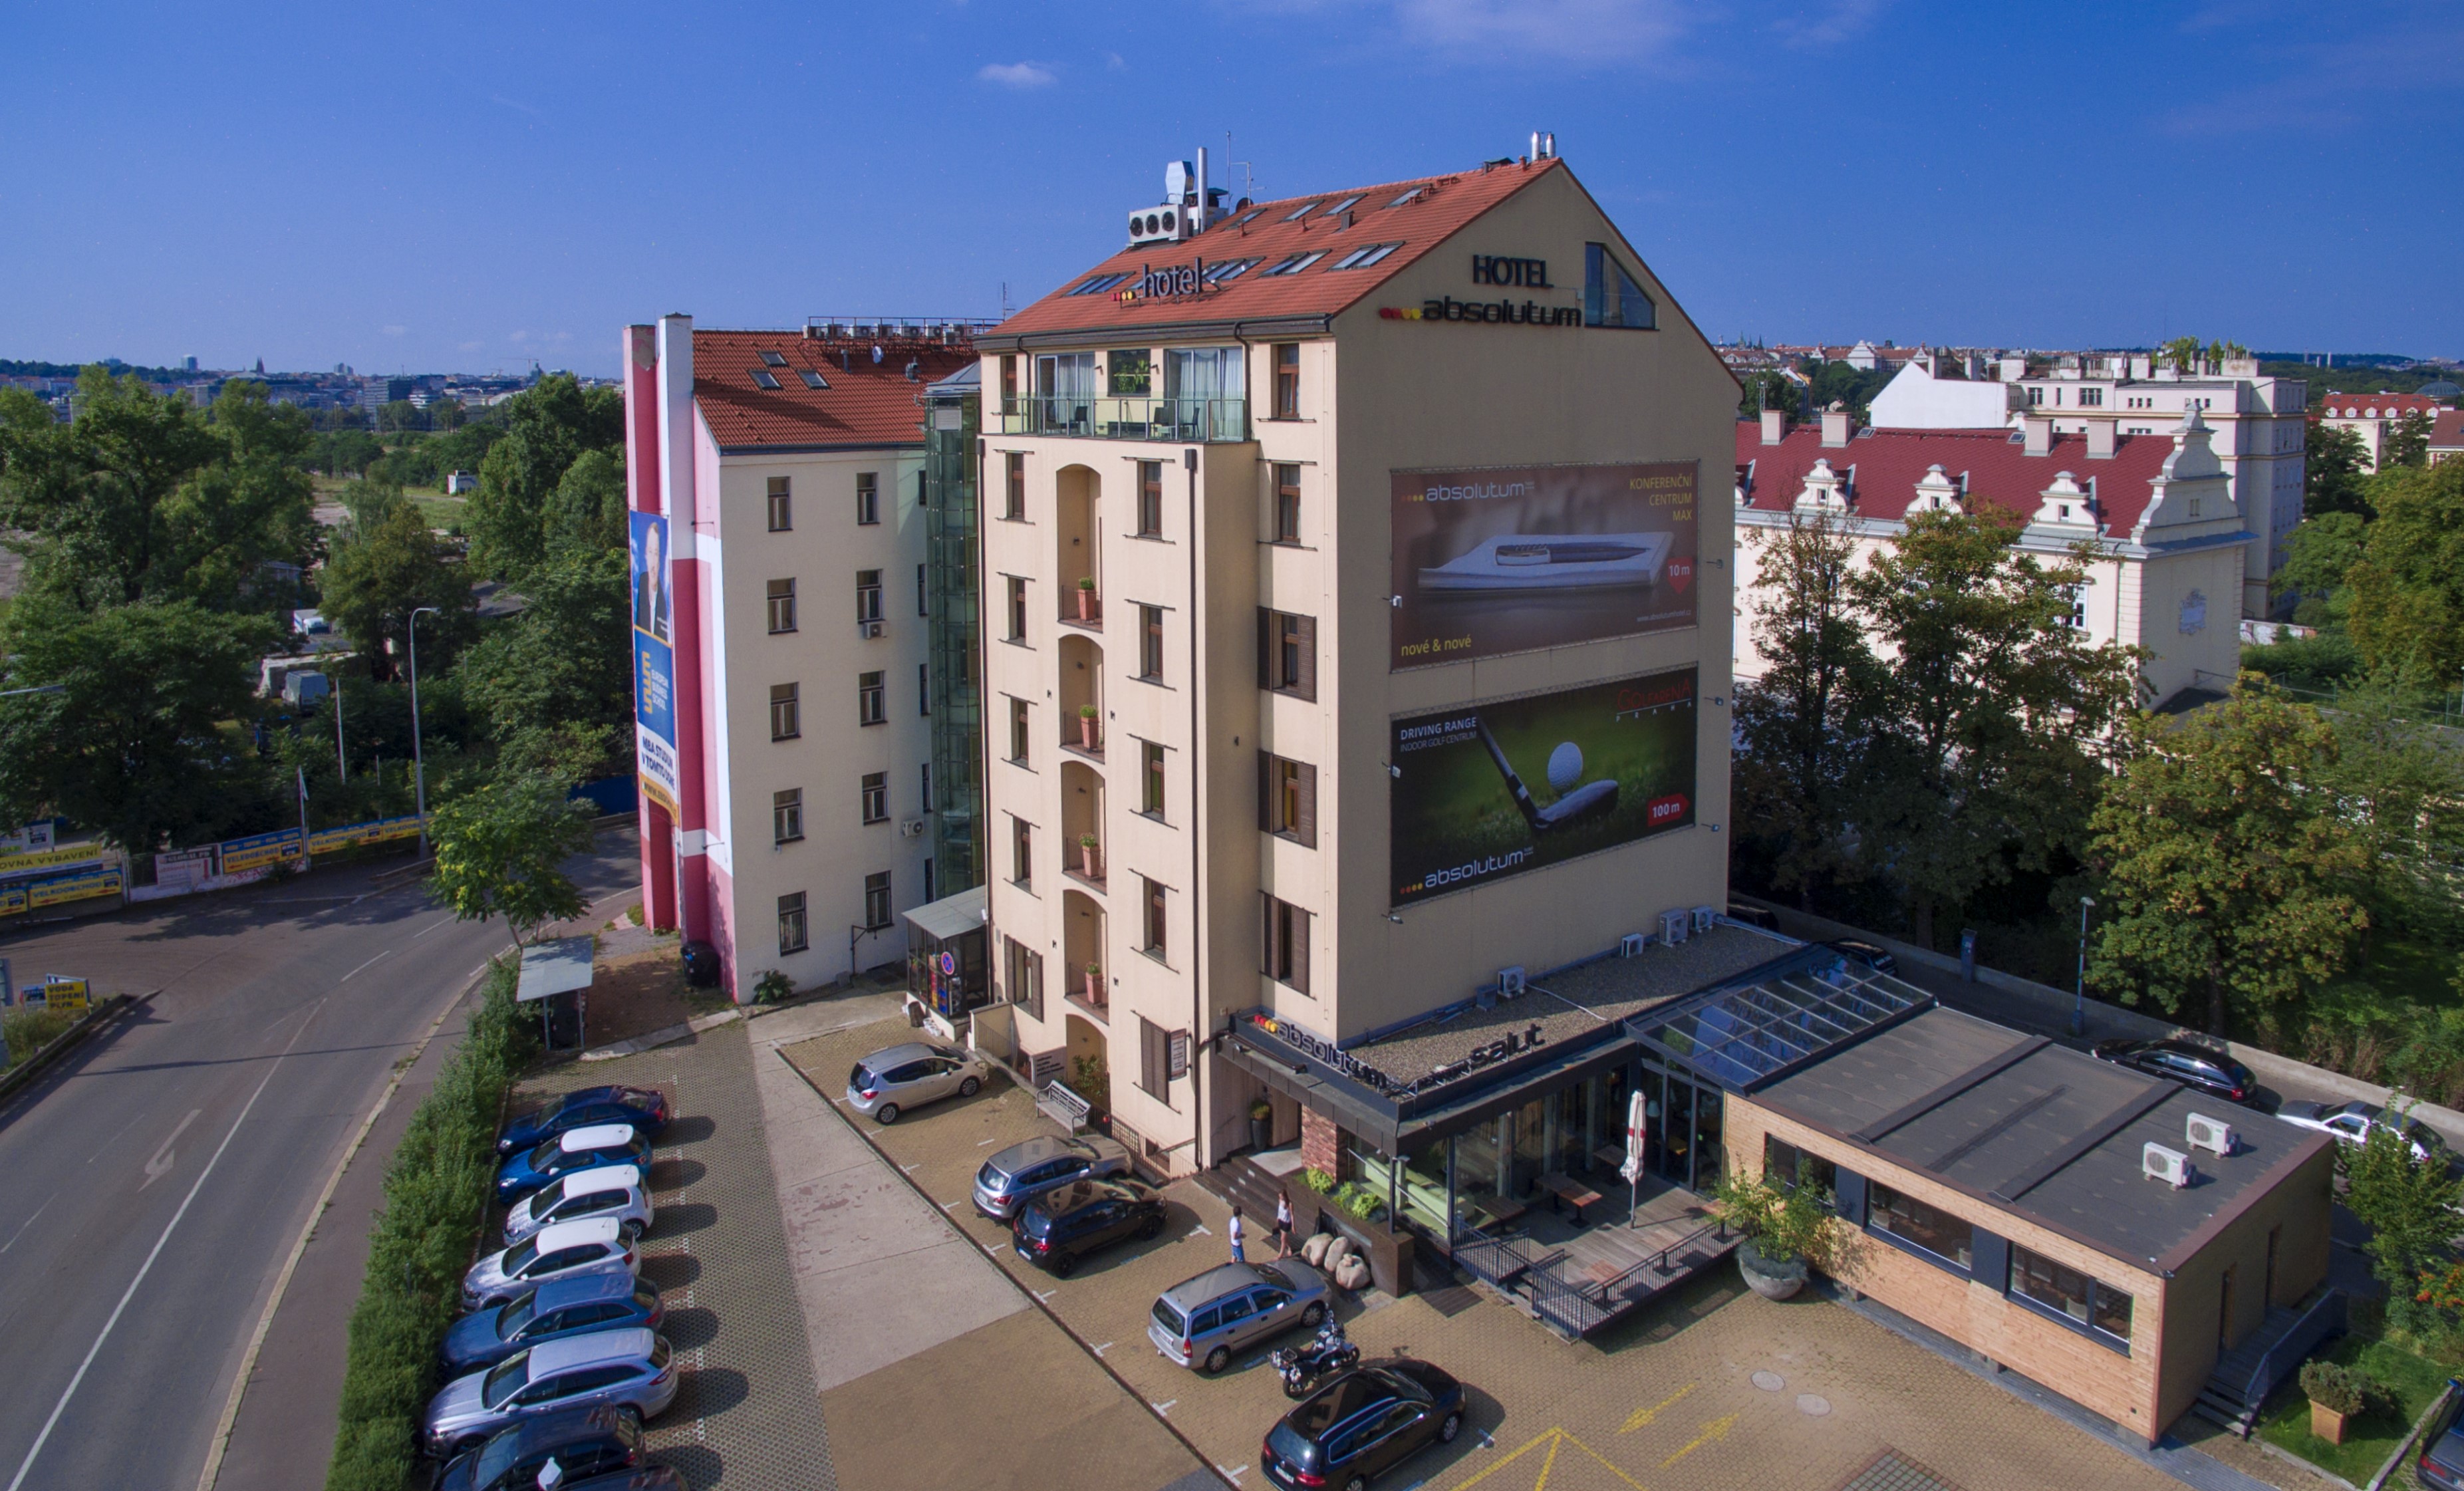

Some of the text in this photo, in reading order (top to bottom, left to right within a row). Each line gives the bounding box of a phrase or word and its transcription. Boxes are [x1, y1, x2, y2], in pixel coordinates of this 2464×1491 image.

[1143, 257, 1202, 298] hotel
[1472, 254, 1555, 289] HOTEL
[1423, 295, 1582, 327] absolutum
[1426, 481, 1524, 502] absolutum
[1629, 472, 1693, 489] KONFERENČNÍ
[1649, 492, 1692, 506] CENTRUM
[1673, 509, 1693, 521] MAX
[1669, 564, 1690, 577] 10 m
[1401, 634, 1472, 656] nové & nové
[1617, 678, 1693, 711] GOLFARENA
[1400, 717, 1477, 740] DRIVING RANGE
[1400, 730, 1477, 753] INDOOR GOLF CENTRUM
[1653, 803, 1680, 818] 100 m
[38, 847, 98, 865] VYBAVENÍ
[1425, 850, 1523, 888] absolutum
[33, 881, 102, 898] VELKOOBCHOD
[49, 990, 84, 1001] TOPENÍ
[1277, 1021, 1387, 1089] absolutum
[1469, 1023, 1546, 1066] salut
